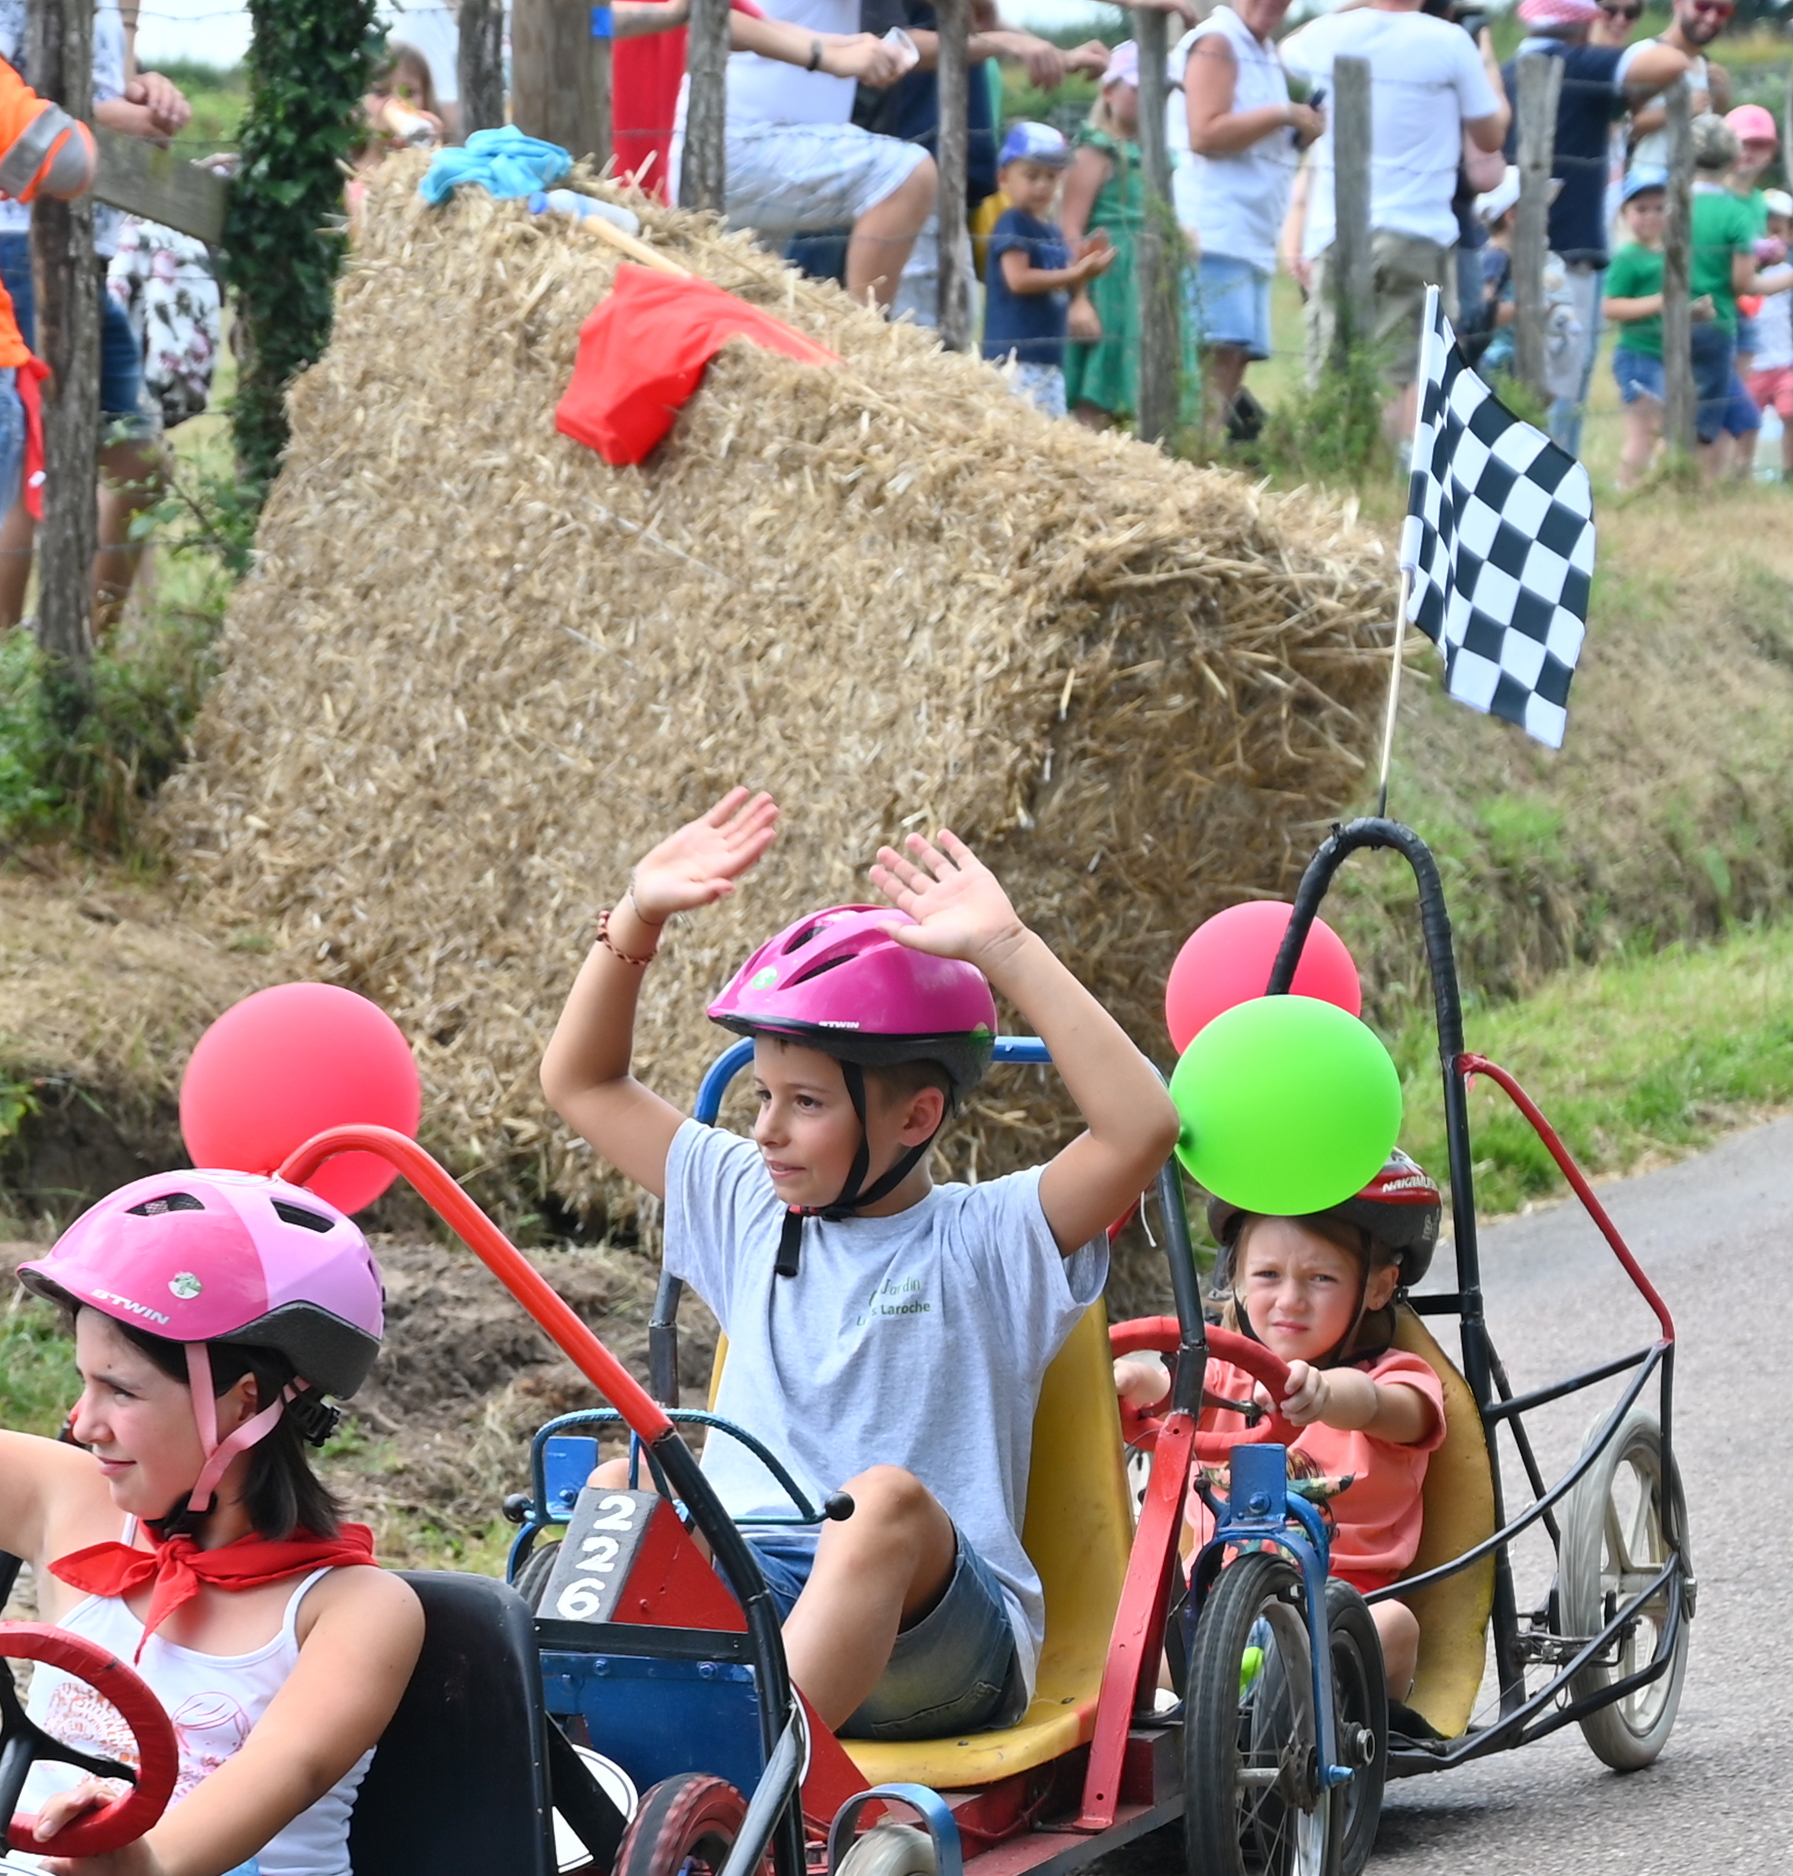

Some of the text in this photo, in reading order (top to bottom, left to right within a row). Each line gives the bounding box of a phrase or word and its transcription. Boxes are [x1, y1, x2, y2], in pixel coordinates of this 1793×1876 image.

[90, 1288, 171, 1326] BTWIN
[880, 1300, 932, 1316] Laroche
[555, 1494, 638, 1621] 226
